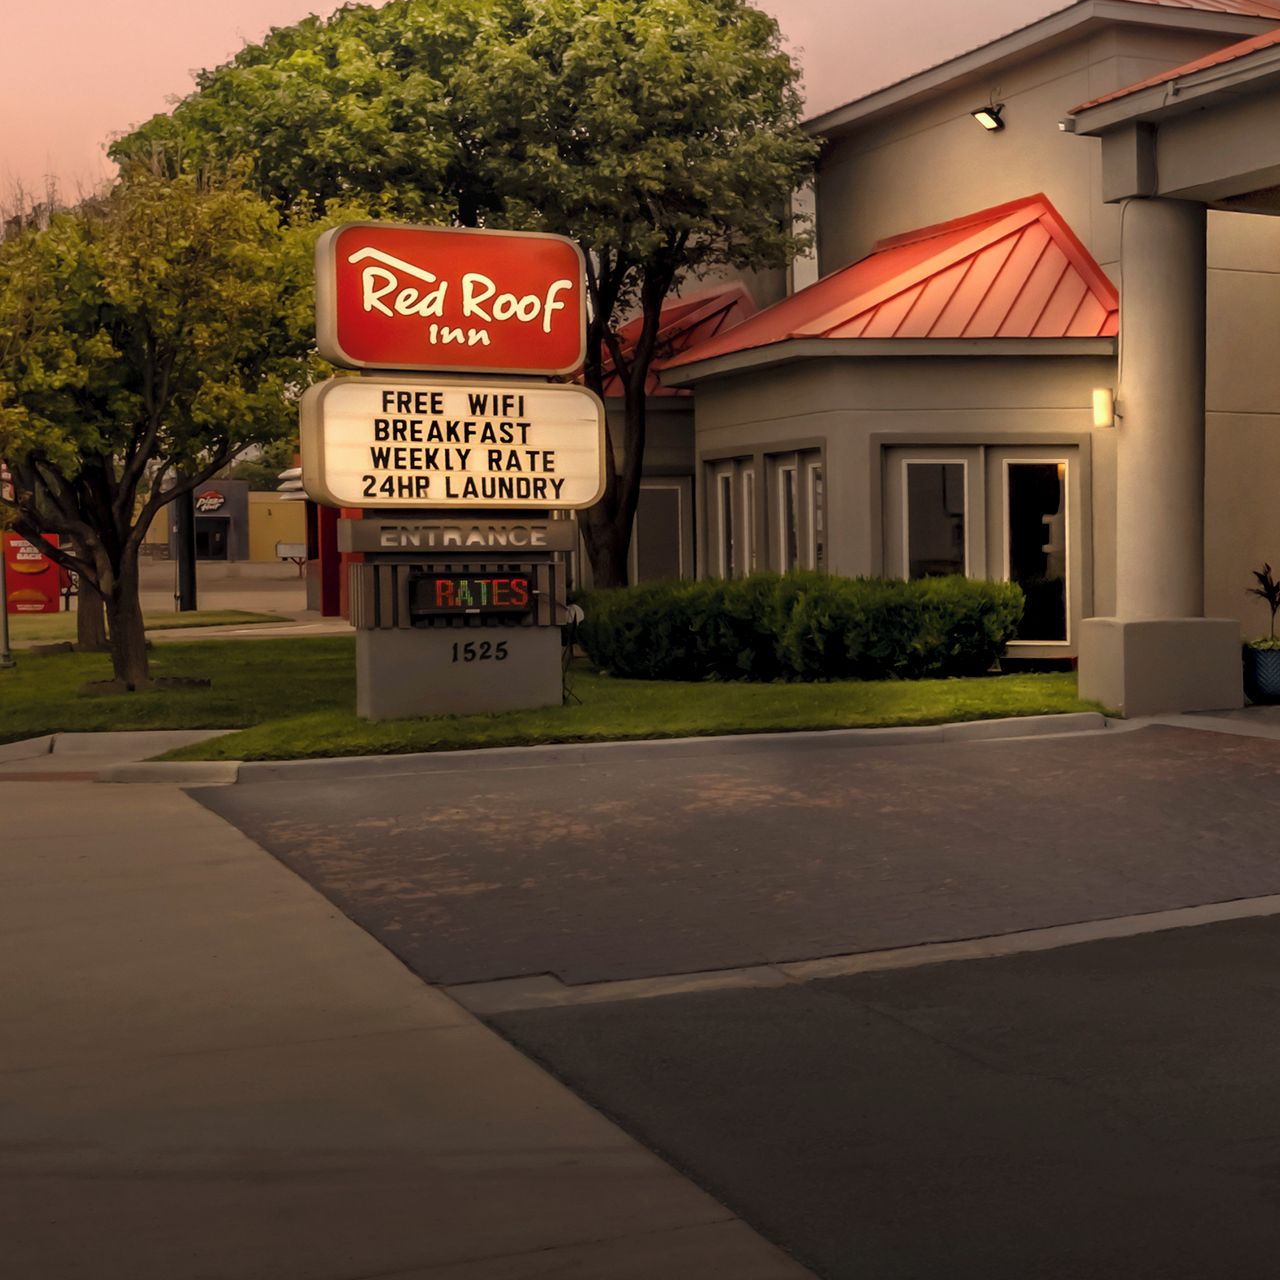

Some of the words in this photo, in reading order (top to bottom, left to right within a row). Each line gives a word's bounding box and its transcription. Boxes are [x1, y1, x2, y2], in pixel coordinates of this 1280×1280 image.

[362, 265, 449, 318] Red
[461, 272, 574, 334] Roof
[428, 323, 492, 347] Inn
[381, 390, 445, 415] FREE
[467, 393, 526, 418] WIFI
[373, 418, 532, 445] BREAKFAST
[370, 446, 472, 471] WEEKLY
[487, 448, 556, 473] RATE
[445, 475, 566, 500] LAUNDRY
[379, 525, 548, 547] ENTRANCE
[434, 578, 529, 607] RATES
[452, 640, 509, 663] 1525
